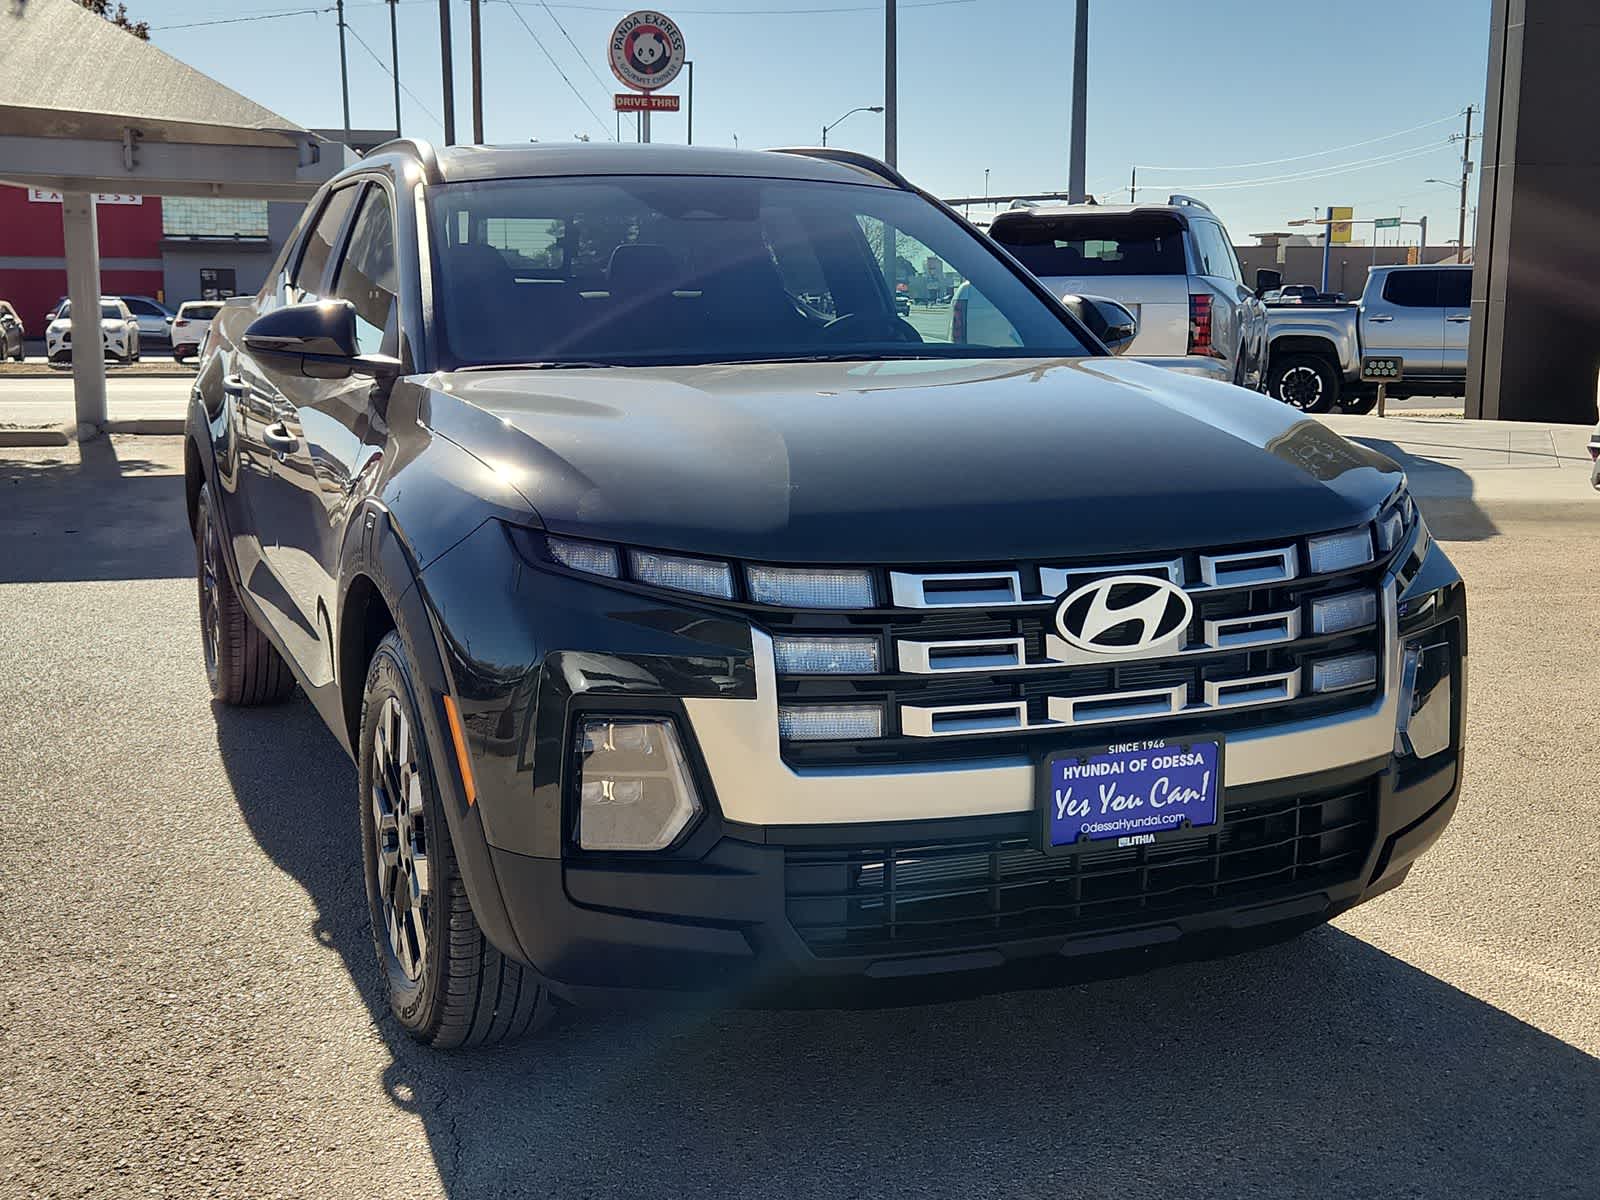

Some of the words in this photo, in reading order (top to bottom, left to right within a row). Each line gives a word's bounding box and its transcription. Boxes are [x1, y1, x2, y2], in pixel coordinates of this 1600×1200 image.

[614, 17, 641, 50] PANDA
[645, 14, 682, 50] EXPRESS
[616, 97, 648, 106] DRIVE
[652, 98, 678, 107] THRU
[1108, 742, 1139, 754] SINCE
[1142, 740, 1165, 750] 1946
[1063, 762, 1125, 780] HYUNDAI
[1129, 759, 1147, 772] OF
[1151, 753, 1204, 769] ODESSA
[1055, 787, 1091, 820] Yes
[1099, 782, 1143, 814] You
[1150, 770, 1210, 808] Can!
[1081, 813, 1185, 834] OdessaHyundai.com
[1127, 833, 1155, 846] LITHIA
